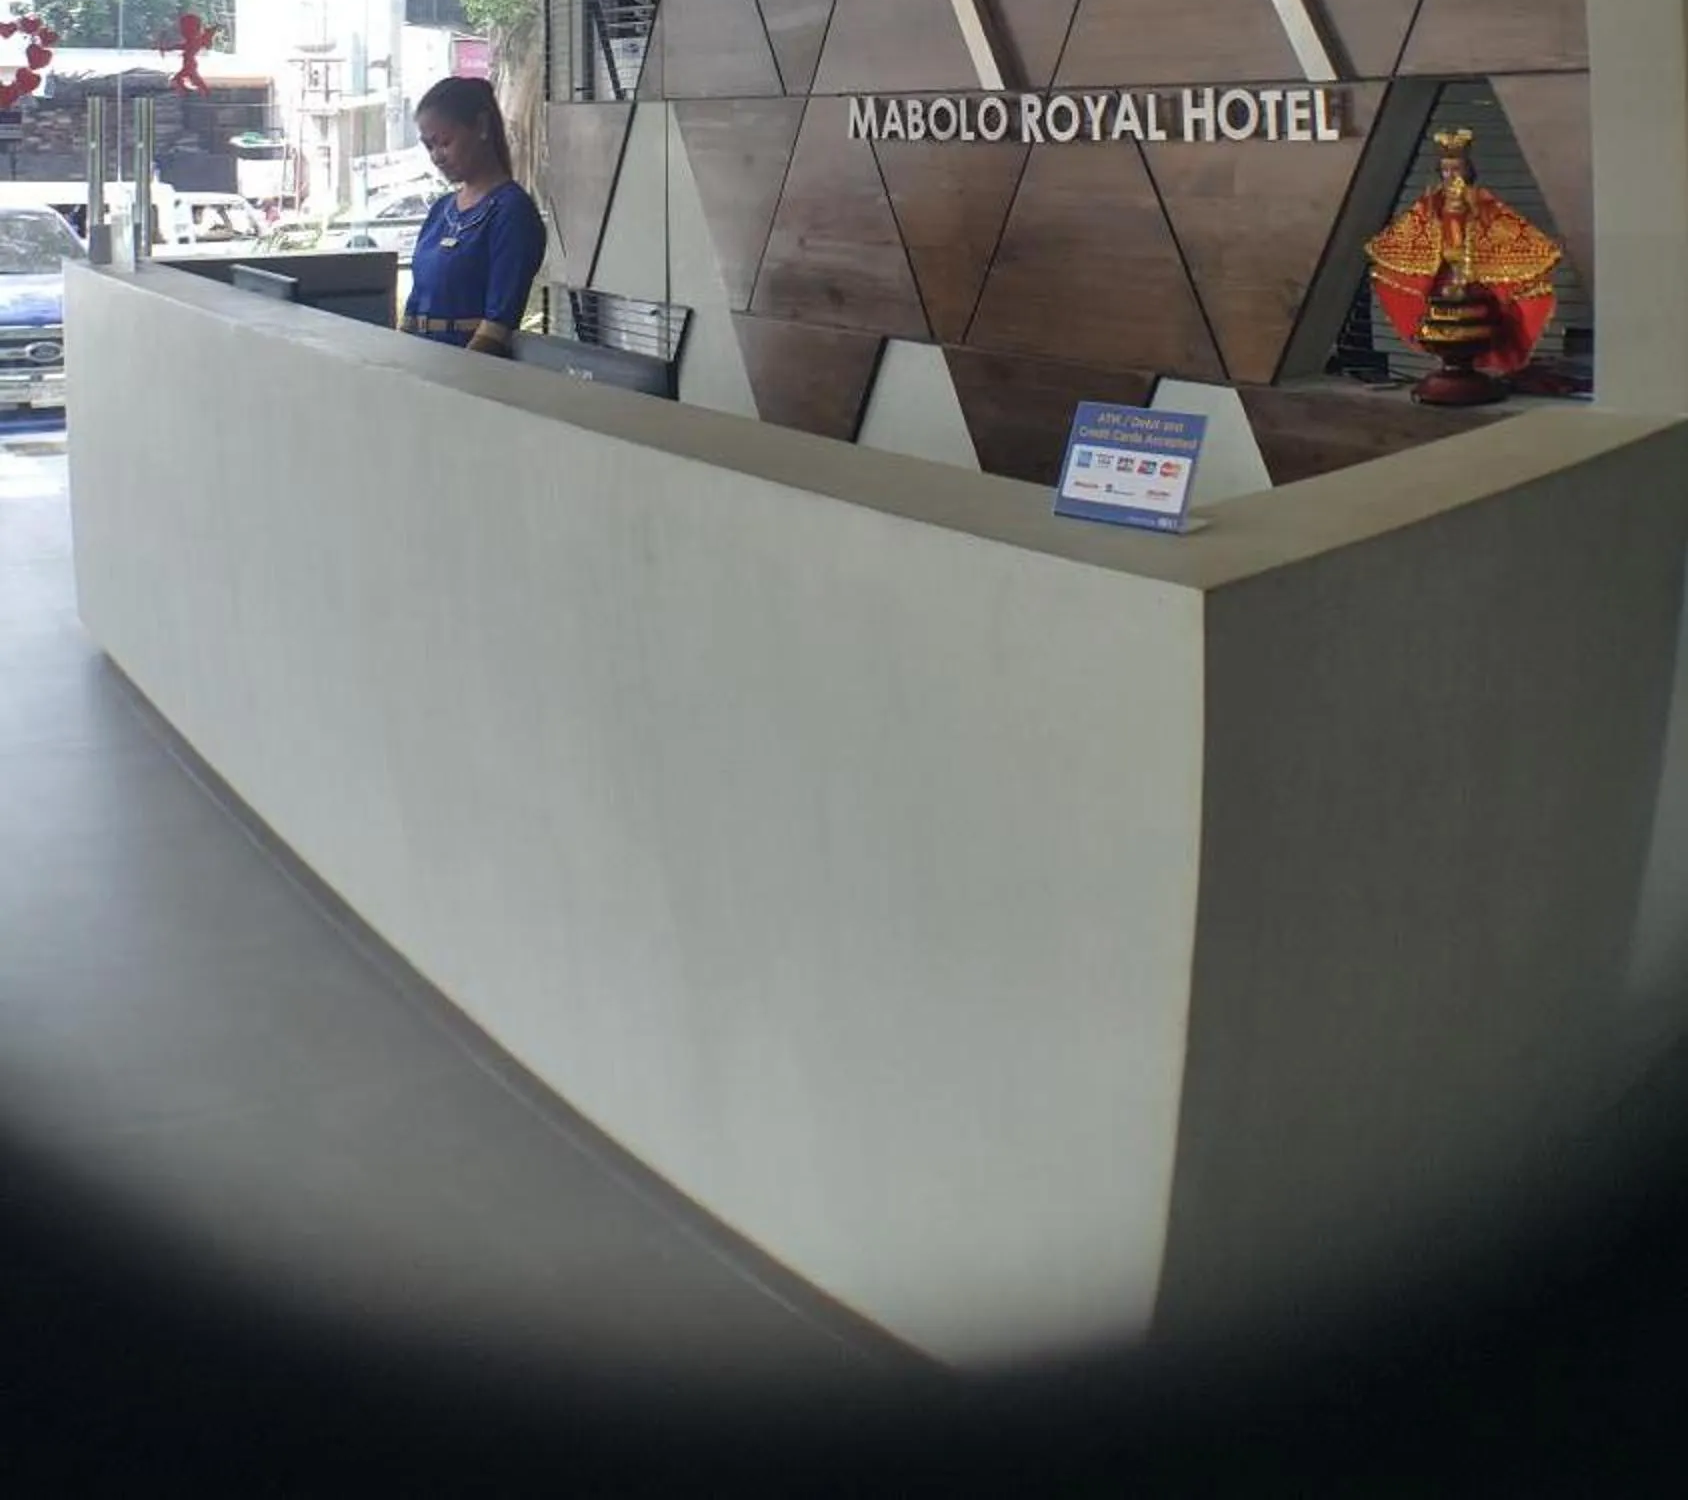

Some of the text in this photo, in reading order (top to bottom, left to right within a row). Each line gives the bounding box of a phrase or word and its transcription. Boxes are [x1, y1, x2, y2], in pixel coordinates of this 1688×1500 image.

[848, 86, 1339, 143] MABOLO ROYAL HOTEL
